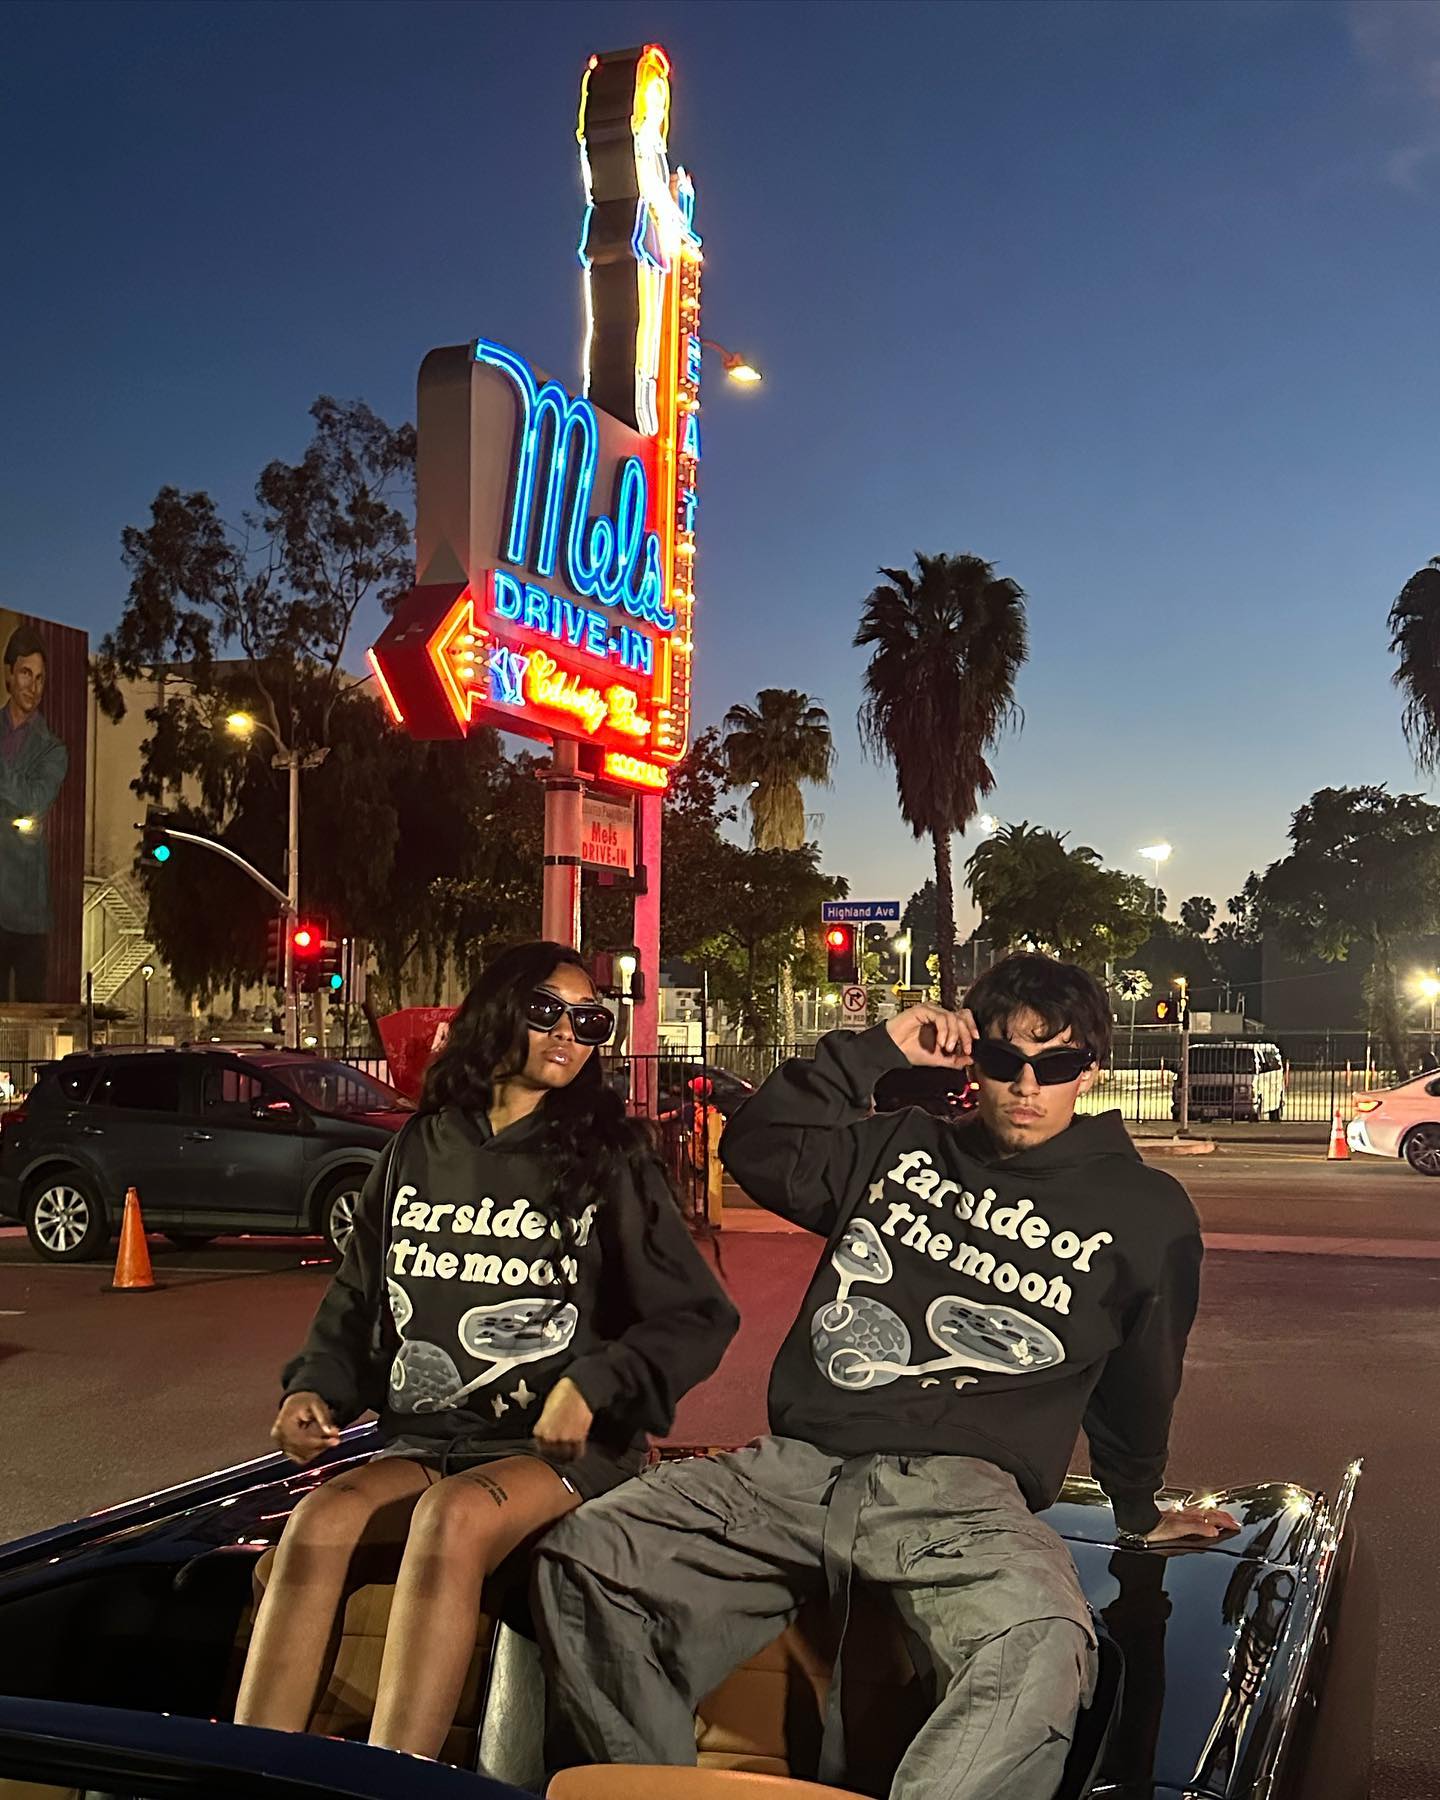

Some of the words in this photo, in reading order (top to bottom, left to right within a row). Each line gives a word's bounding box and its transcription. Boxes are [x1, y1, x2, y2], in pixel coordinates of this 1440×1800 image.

[475, 337, 676, 632] Mels
[492, 567, 654, 676] DRIVE-IN
[591, 821, 618, 846] Mels
[582, 841, 627, 866] DRIVE-IN
[827, 906, 871, 920] Highland
[875, 906, 895, 917] Ave
